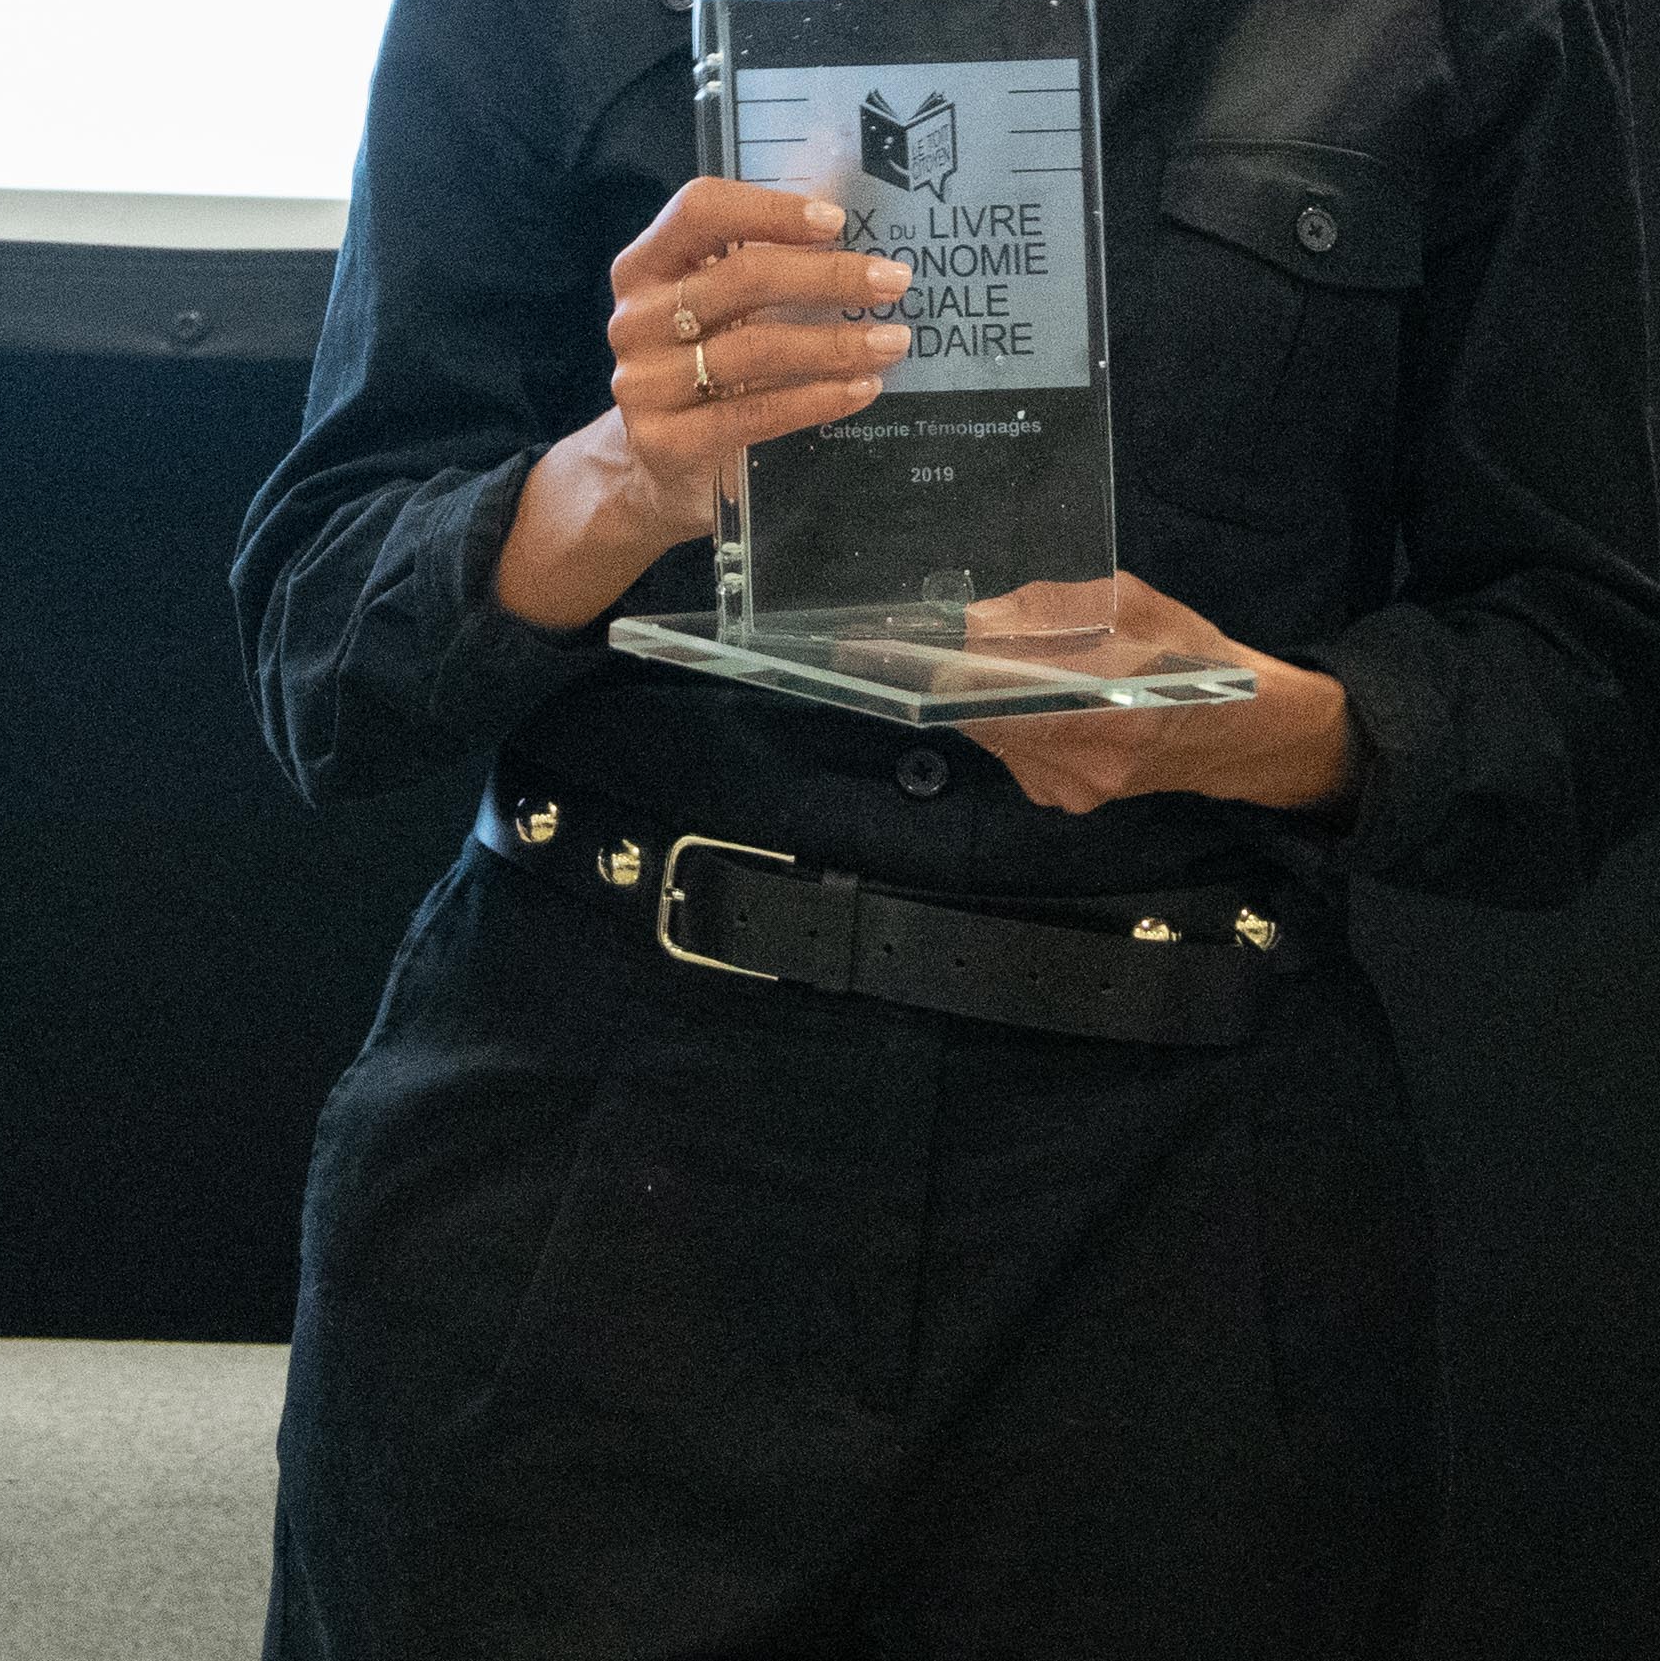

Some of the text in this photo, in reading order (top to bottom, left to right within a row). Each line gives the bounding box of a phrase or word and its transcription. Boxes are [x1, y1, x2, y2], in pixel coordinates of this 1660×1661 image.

[889, 224, 916, 241] DU
[929, 203, 1043, 239] LIVRE
[819, 419, 1042, 441] Catégorie Témoignages
[910, 466, 955, 483] 2019
